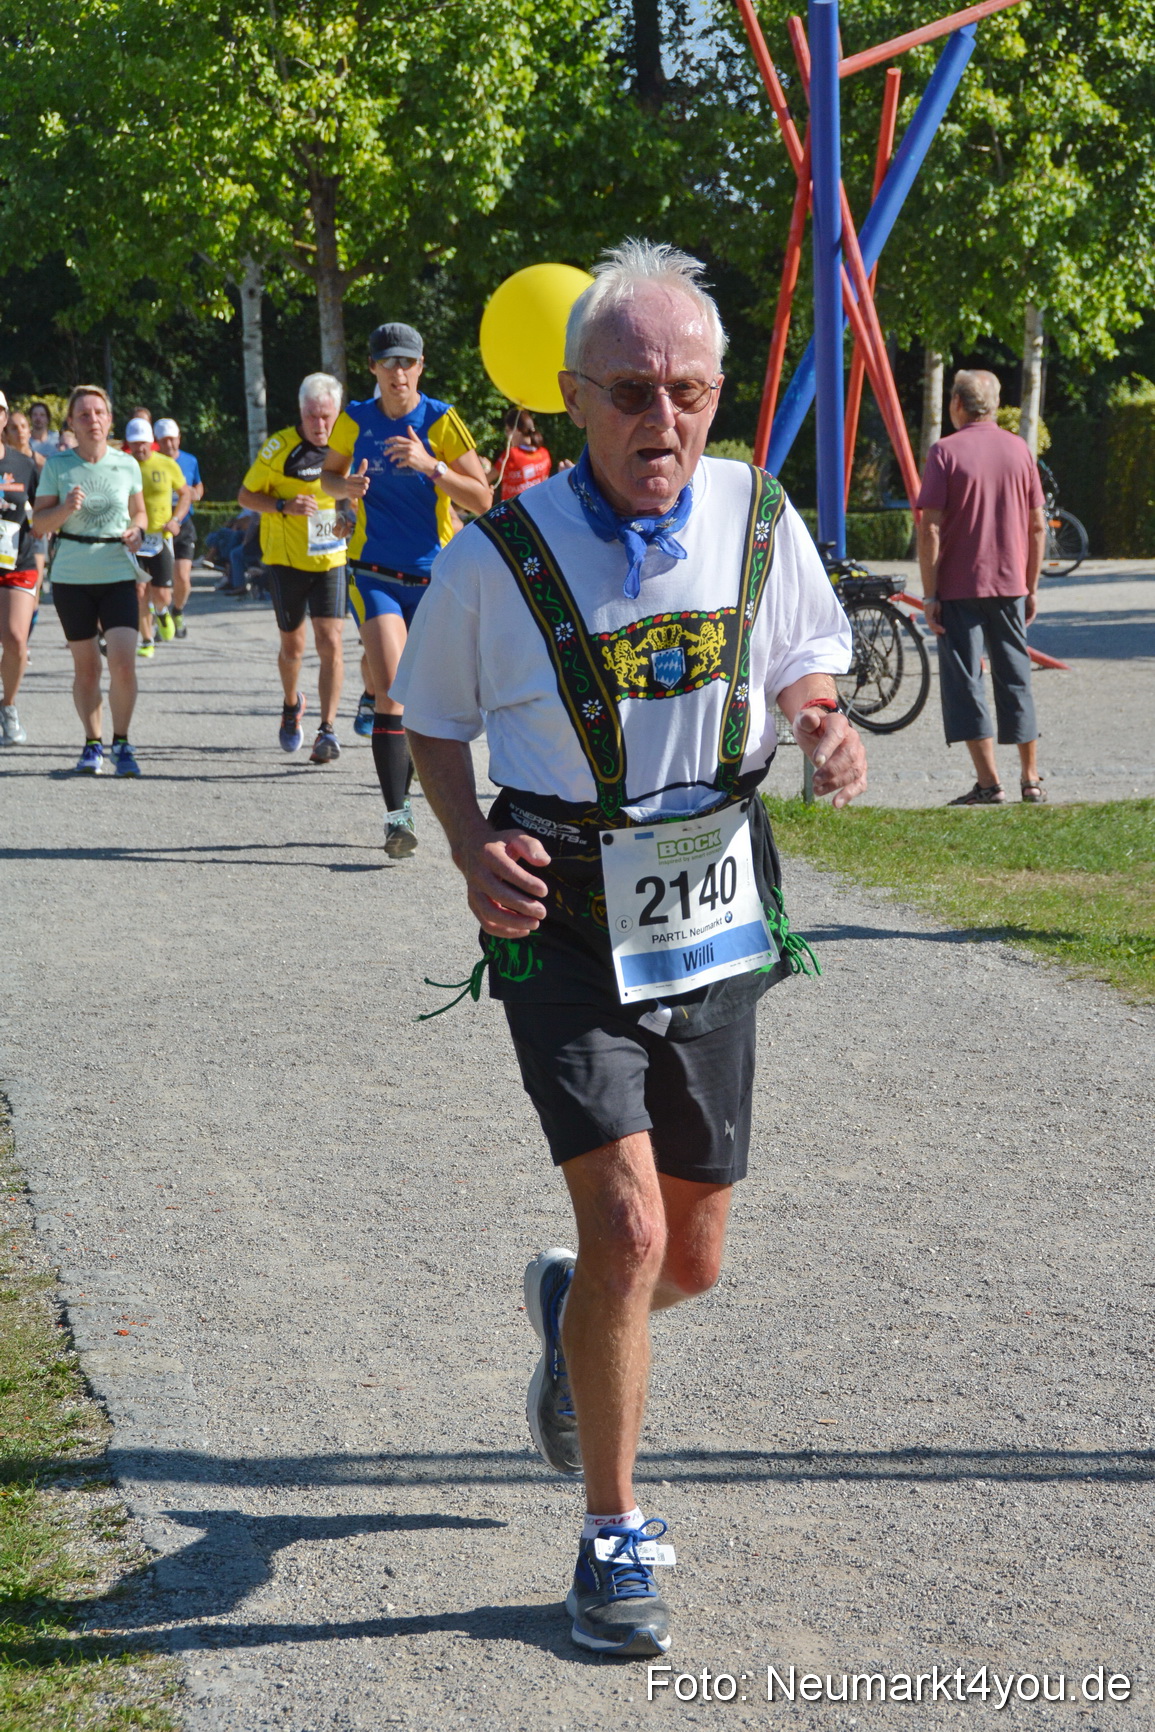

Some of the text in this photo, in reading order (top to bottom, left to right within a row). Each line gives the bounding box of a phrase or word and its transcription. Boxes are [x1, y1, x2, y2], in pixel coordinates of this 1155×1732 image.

[509, 802, 560, 829] SYNERGY
[657, 827, 722, 859] BOCK
[635, 855, 737, 927] 2140
[620, 919, 628, 929] C
[652, 917, 723, 944] PARTL Neumarkt
[682, 942, 715, 972] Willi
